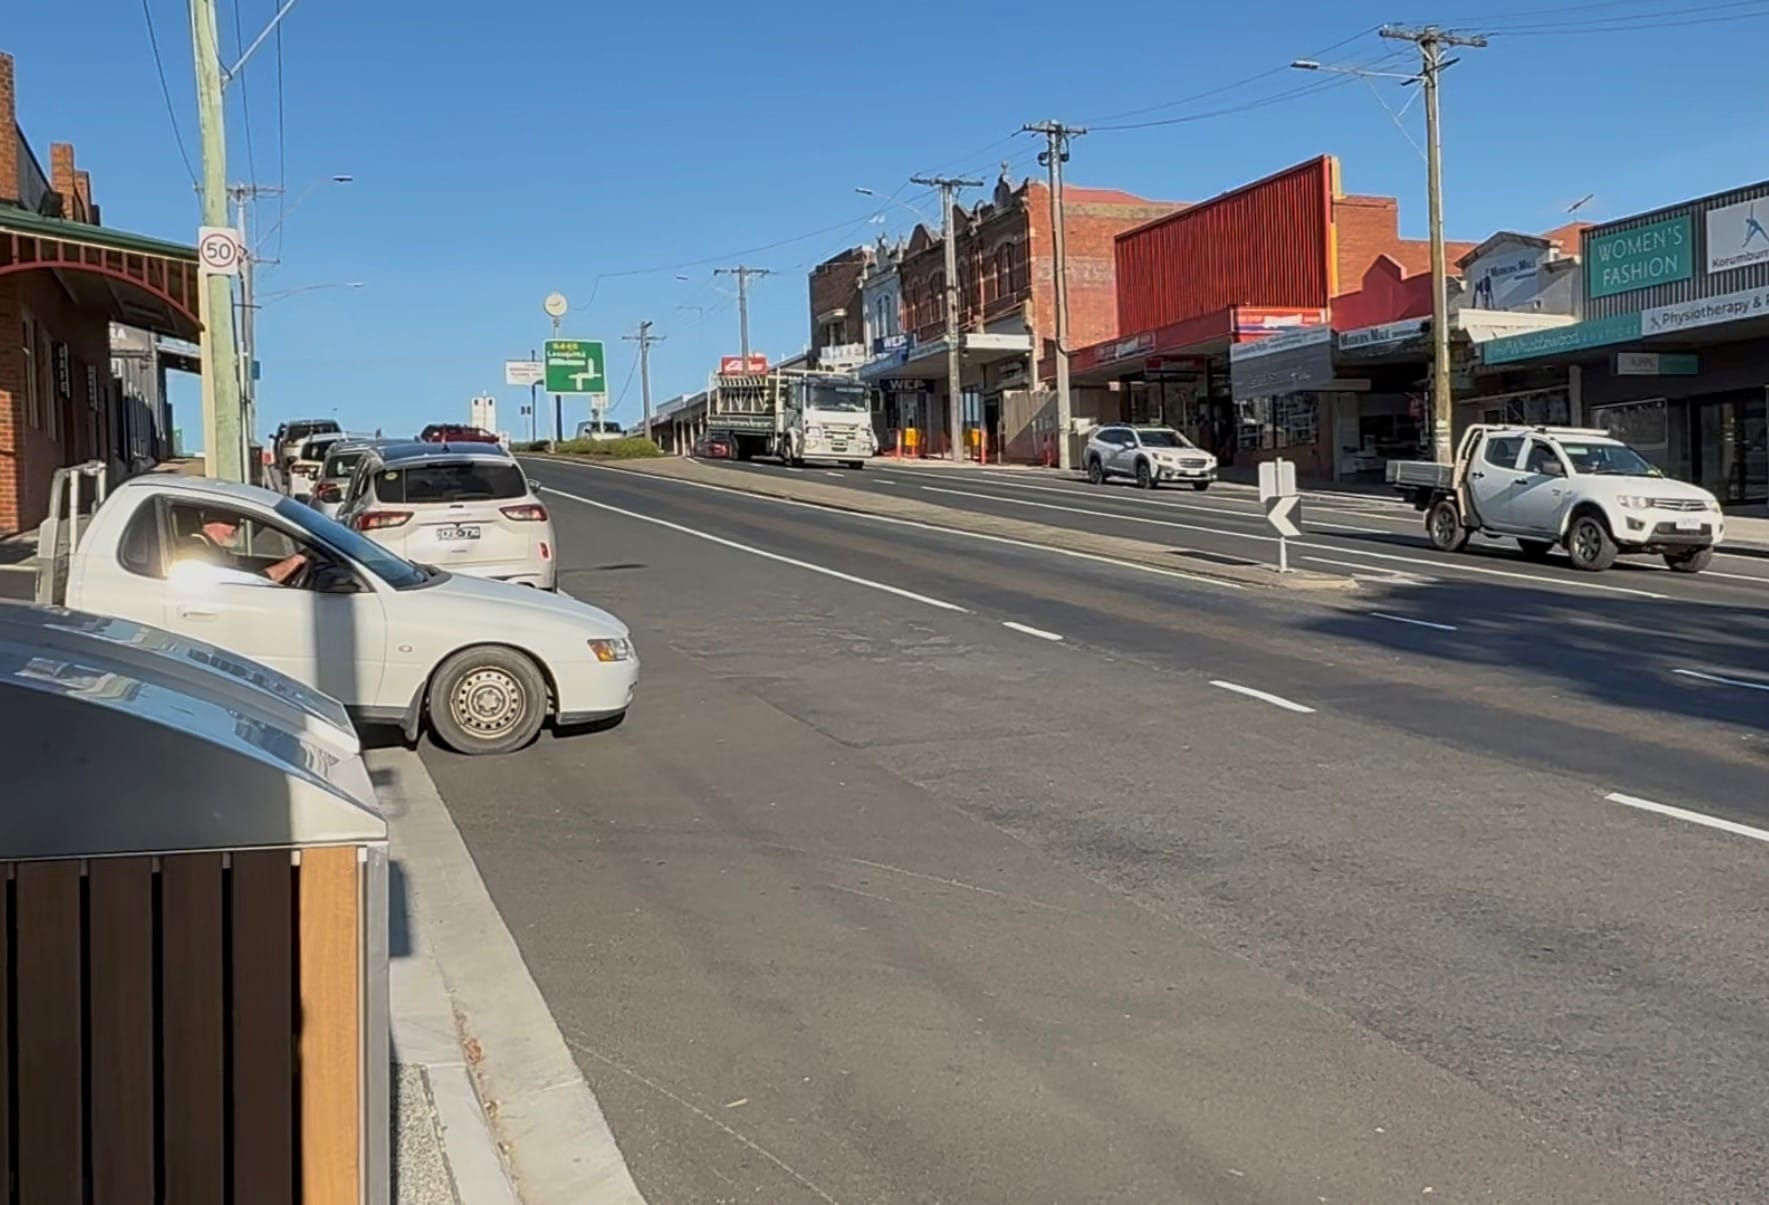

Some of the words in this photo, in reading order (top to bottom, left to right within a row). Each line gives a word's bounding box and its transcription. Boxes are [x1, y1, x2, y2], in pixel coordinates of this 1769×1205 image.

[207, 242, 232, 261] 50
[1598, 225, 1683, 262] WOMEN'S
[1603, 255, 1678, 287] FASHION
[1662, 299, 1749, 324] Physiotherapy
[1752, 296, 1762, 308] &
